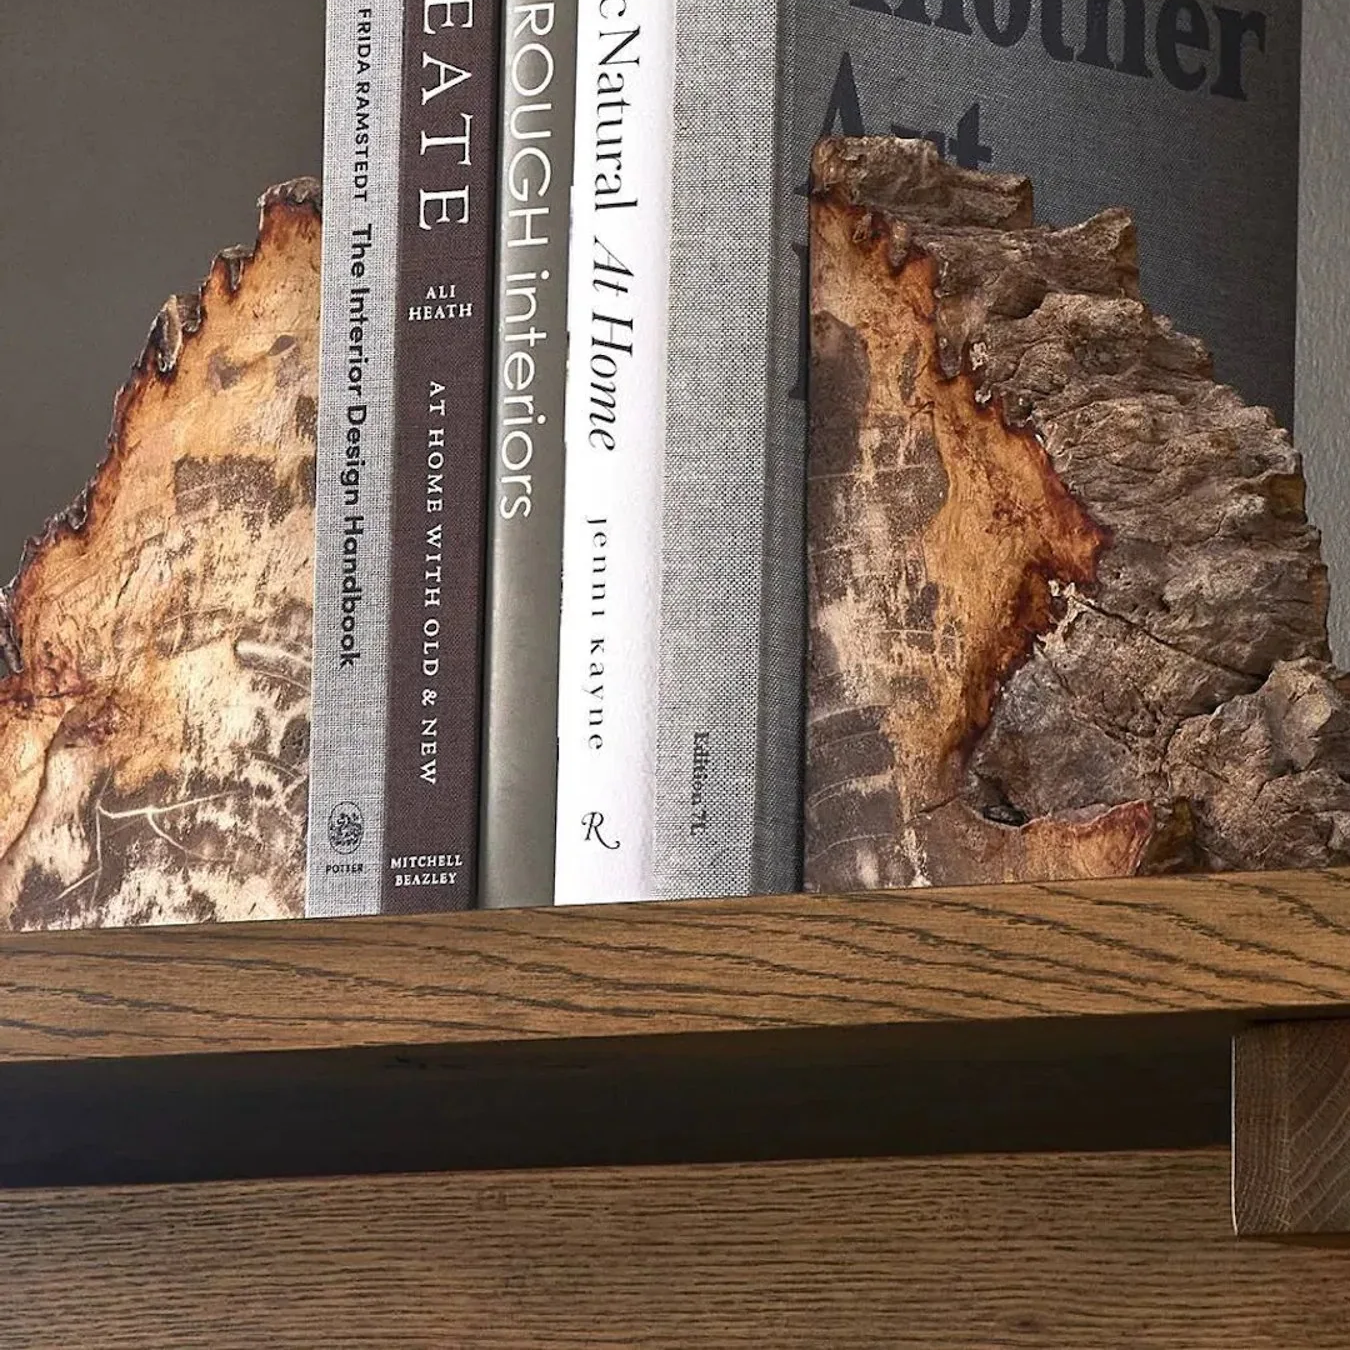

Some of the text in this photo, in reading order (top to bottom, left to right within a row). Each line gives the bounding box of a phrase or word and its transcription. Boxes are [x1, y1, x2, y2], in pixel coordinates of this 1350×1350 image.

[352, 8, 372, 203] FRIDA RAMSTEDT
[594, 25, 642, 212] Natural
[425, 284, 456, 301] ALI
[500, 2, 555, 520] ROUGH interiors
[593, 235, 635, 297] At
[408, 303, 473, 321] HEATH
[588, 311, 634, 451] Home
[339, 223, 373, 669] The Interior Design Handbook
[419, 381, 446, 785] AT HOME WITH OLD & NEW
[325, 863, 364, 875] POTTER
[390, 854, 464, 870] MITCHELL
[394, 872, 458, 887] BEAZLEY
